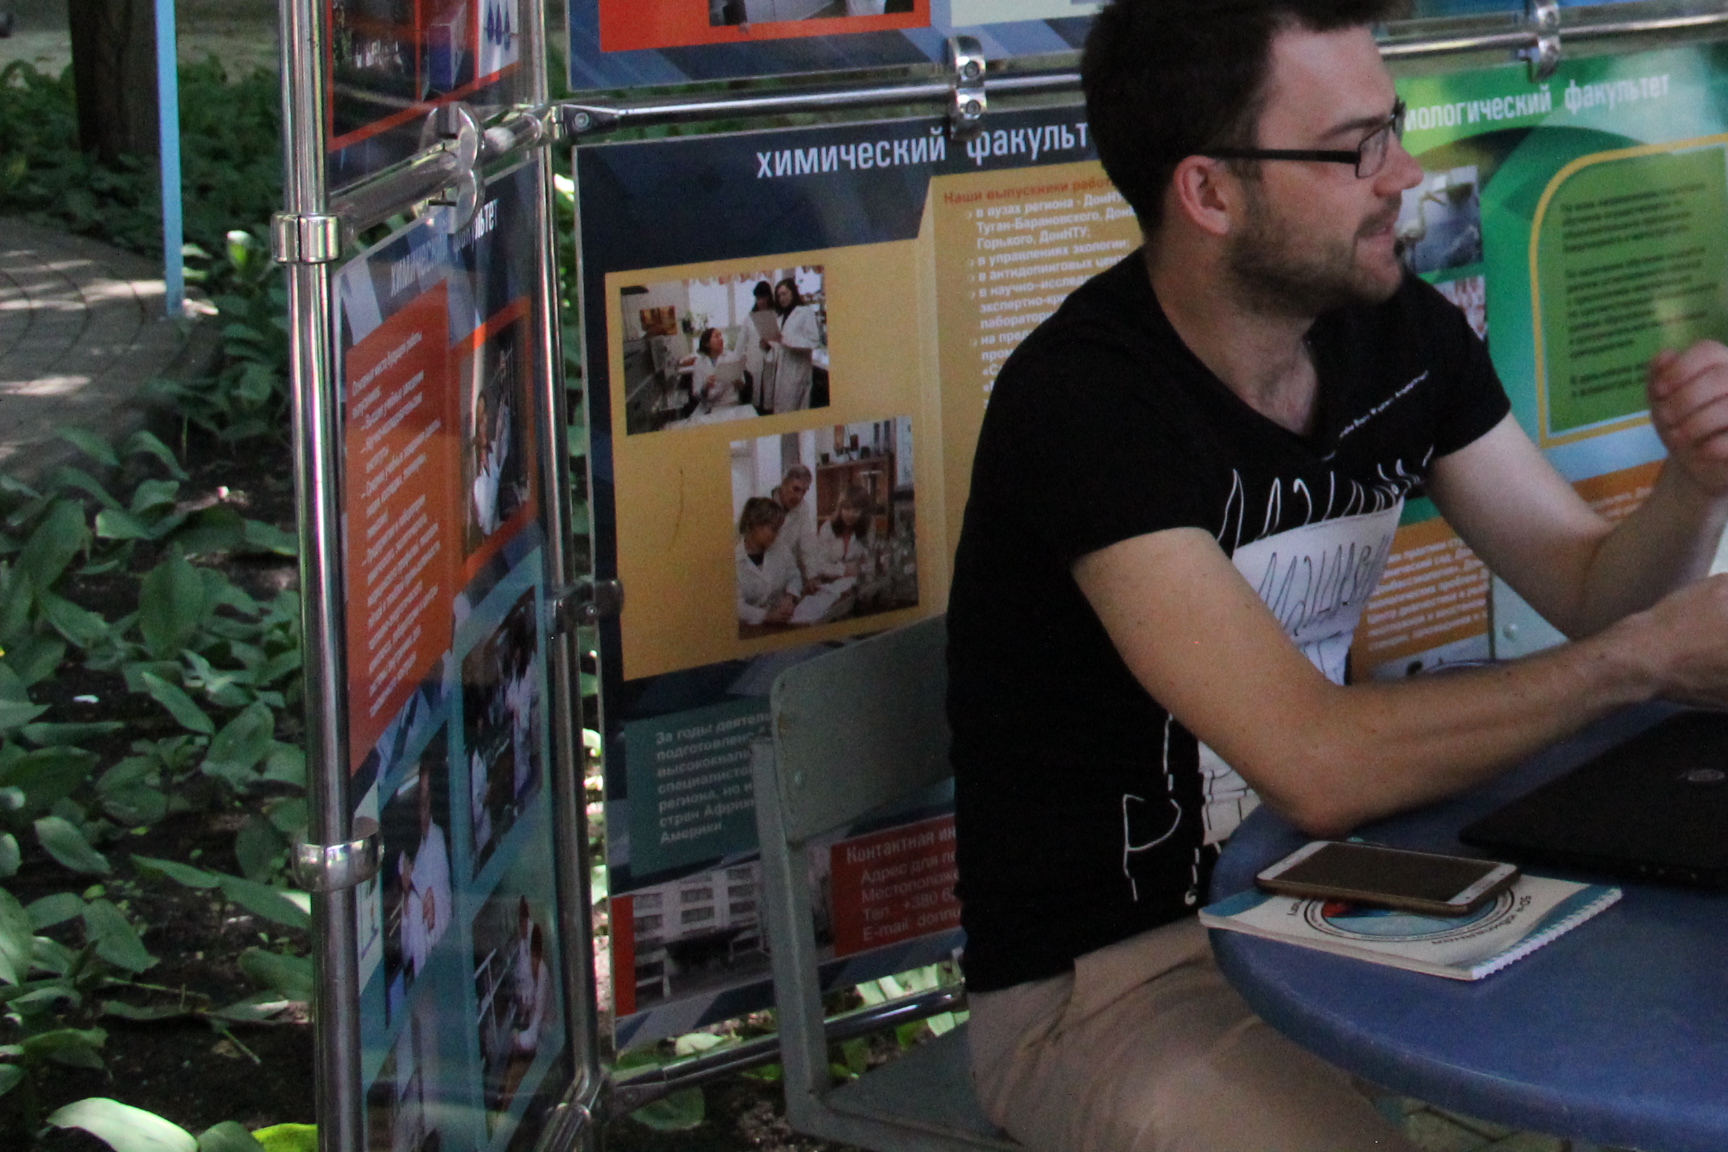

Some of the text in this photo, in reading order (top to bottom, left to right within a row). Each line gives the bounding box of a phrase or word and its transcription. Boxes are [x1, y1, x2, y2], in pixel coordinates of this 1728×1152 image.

[1404, 75, 1669, 132] иологический факультет
[757, 123, 1088, 179] химический факульт
[944, 184, 1069, 205] Наши выпускники
[987, 204, 1021, 218] вузах
[1025, 198, 1073, 215] региона
[977, 234, 1036, 250] Горького,
[990, 246, 1069, 266] управлениях
[990, 261, 1092, 281] антидопинговых
[656, 732, 673, 744] За
[847, 832, 934, 864] Контактная
[861, 856, 938, 885] Адрес для
